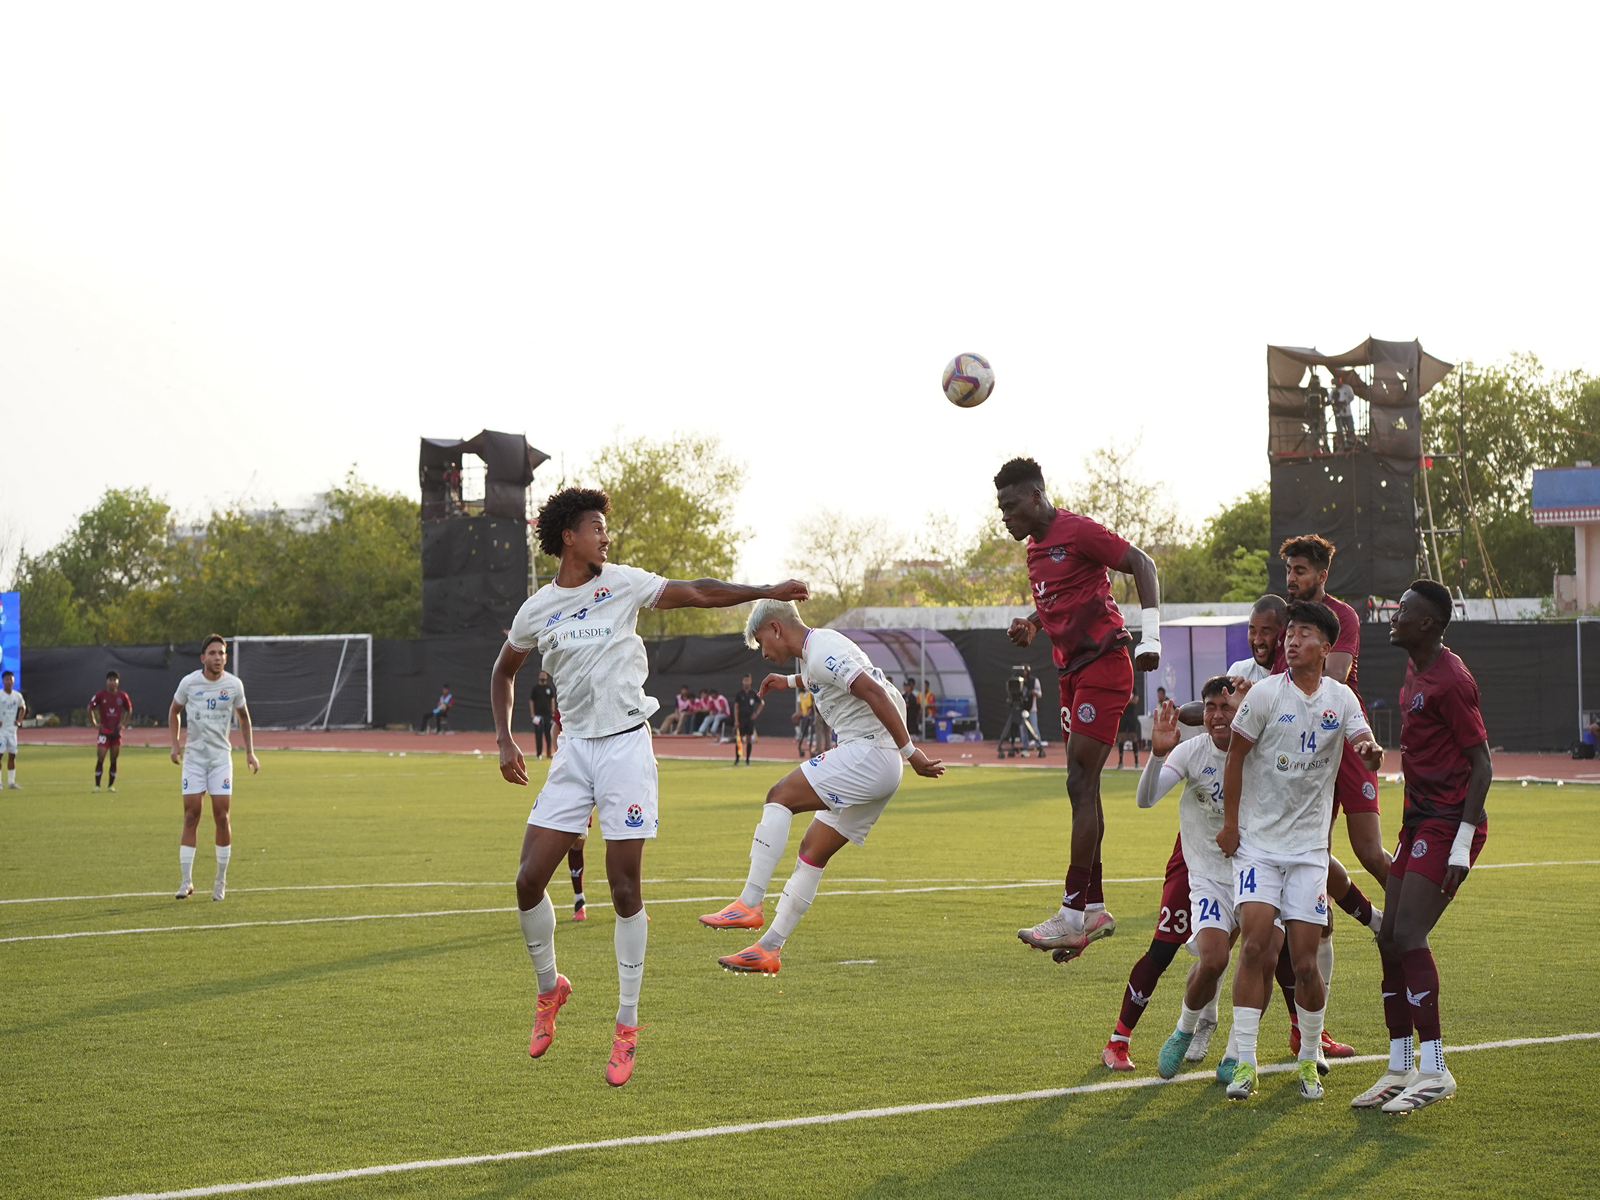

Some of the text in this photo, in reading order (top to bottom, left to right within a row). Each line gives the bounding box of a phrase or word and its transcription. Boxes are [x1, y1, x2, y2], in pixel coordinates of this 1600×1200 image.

[206, 699, 216, 710] 19
[1300, 731, 1316, 753] 14
[1239, 867, 1256, 895] 14
[1158, 906, 1188, 934] 23
[1199, 898, 1221, 922] 24
